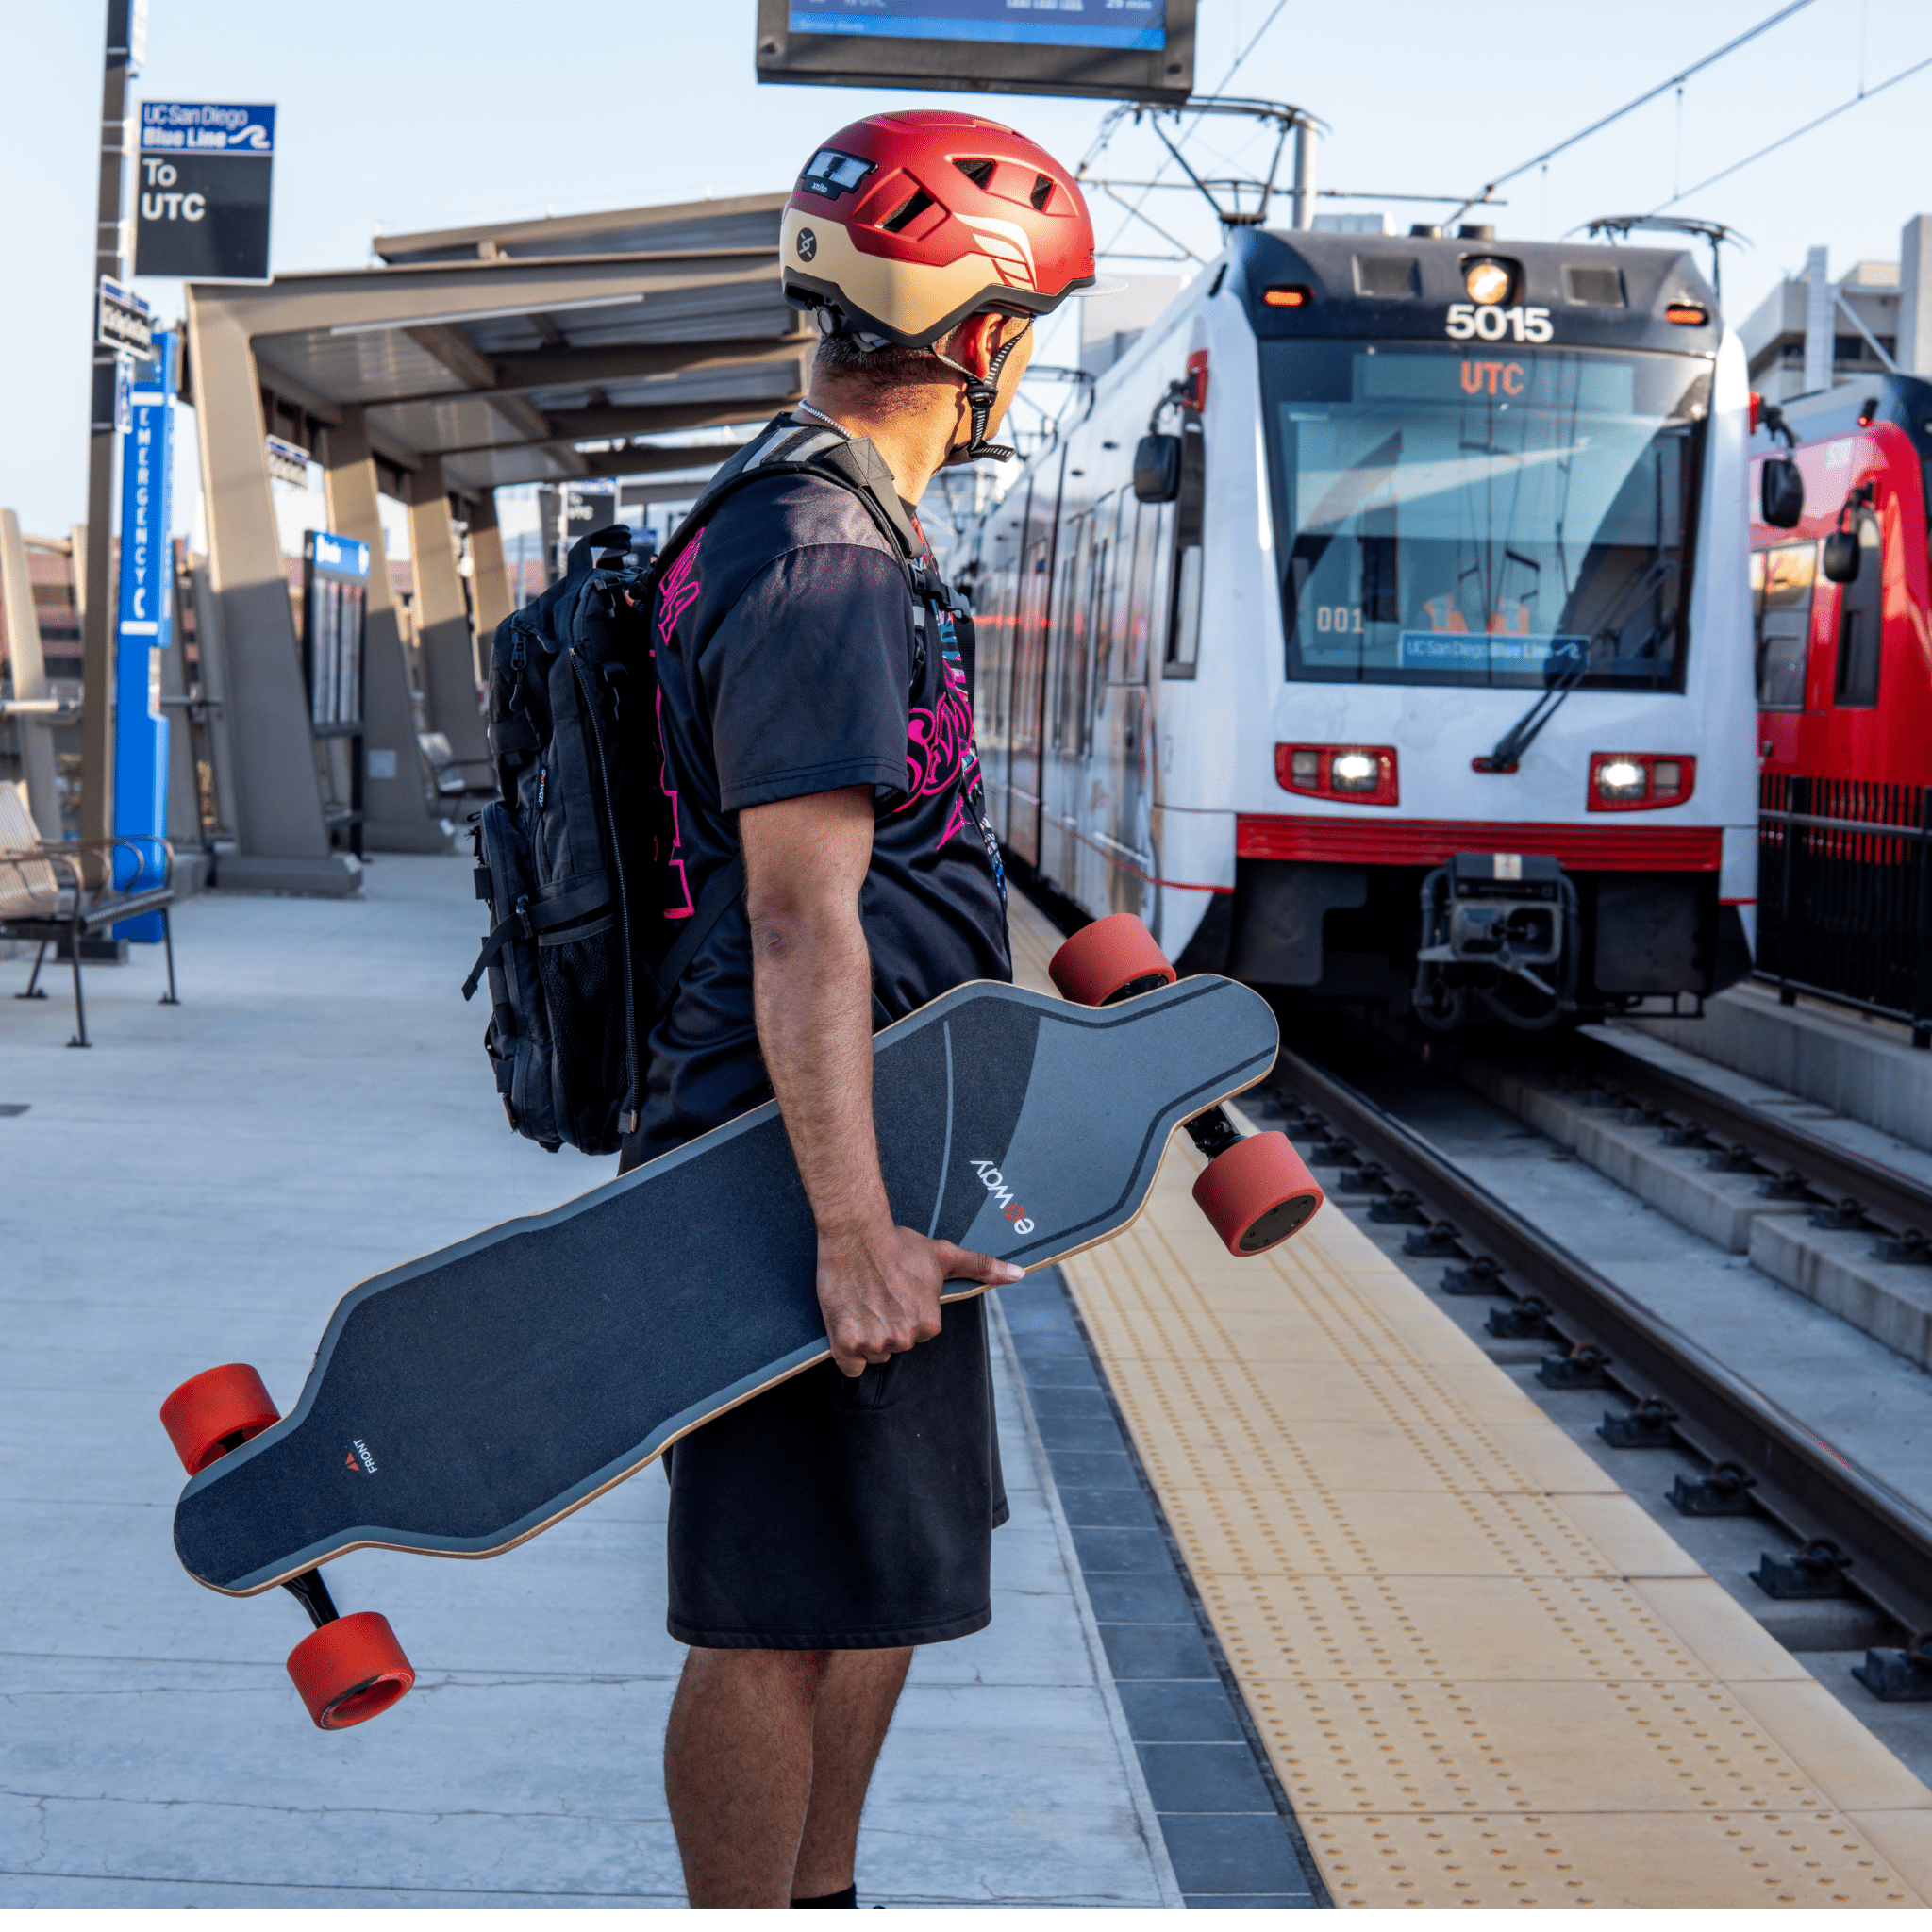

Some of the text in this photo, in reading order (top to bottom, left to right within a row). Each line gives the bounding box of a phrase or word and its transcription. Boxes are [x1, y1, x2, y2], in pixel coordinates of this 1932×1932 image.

[144, 105, 248, 130] UC San Diego
[143, 126, 227, 148] Blue Line
[142, 158, 177, 187] To
[142, 192, 206, 222] UTC
[1445, 303, 1554, 343] 5015
[1460, 360, 1524, 396] UTC
[135, 408, 151, 584] EMERGENCY
[1317, 607, 1364, 632] 001
[970, 1160, 1035, 1235] exway
[353, 1439, 378, 1474] FRONT
